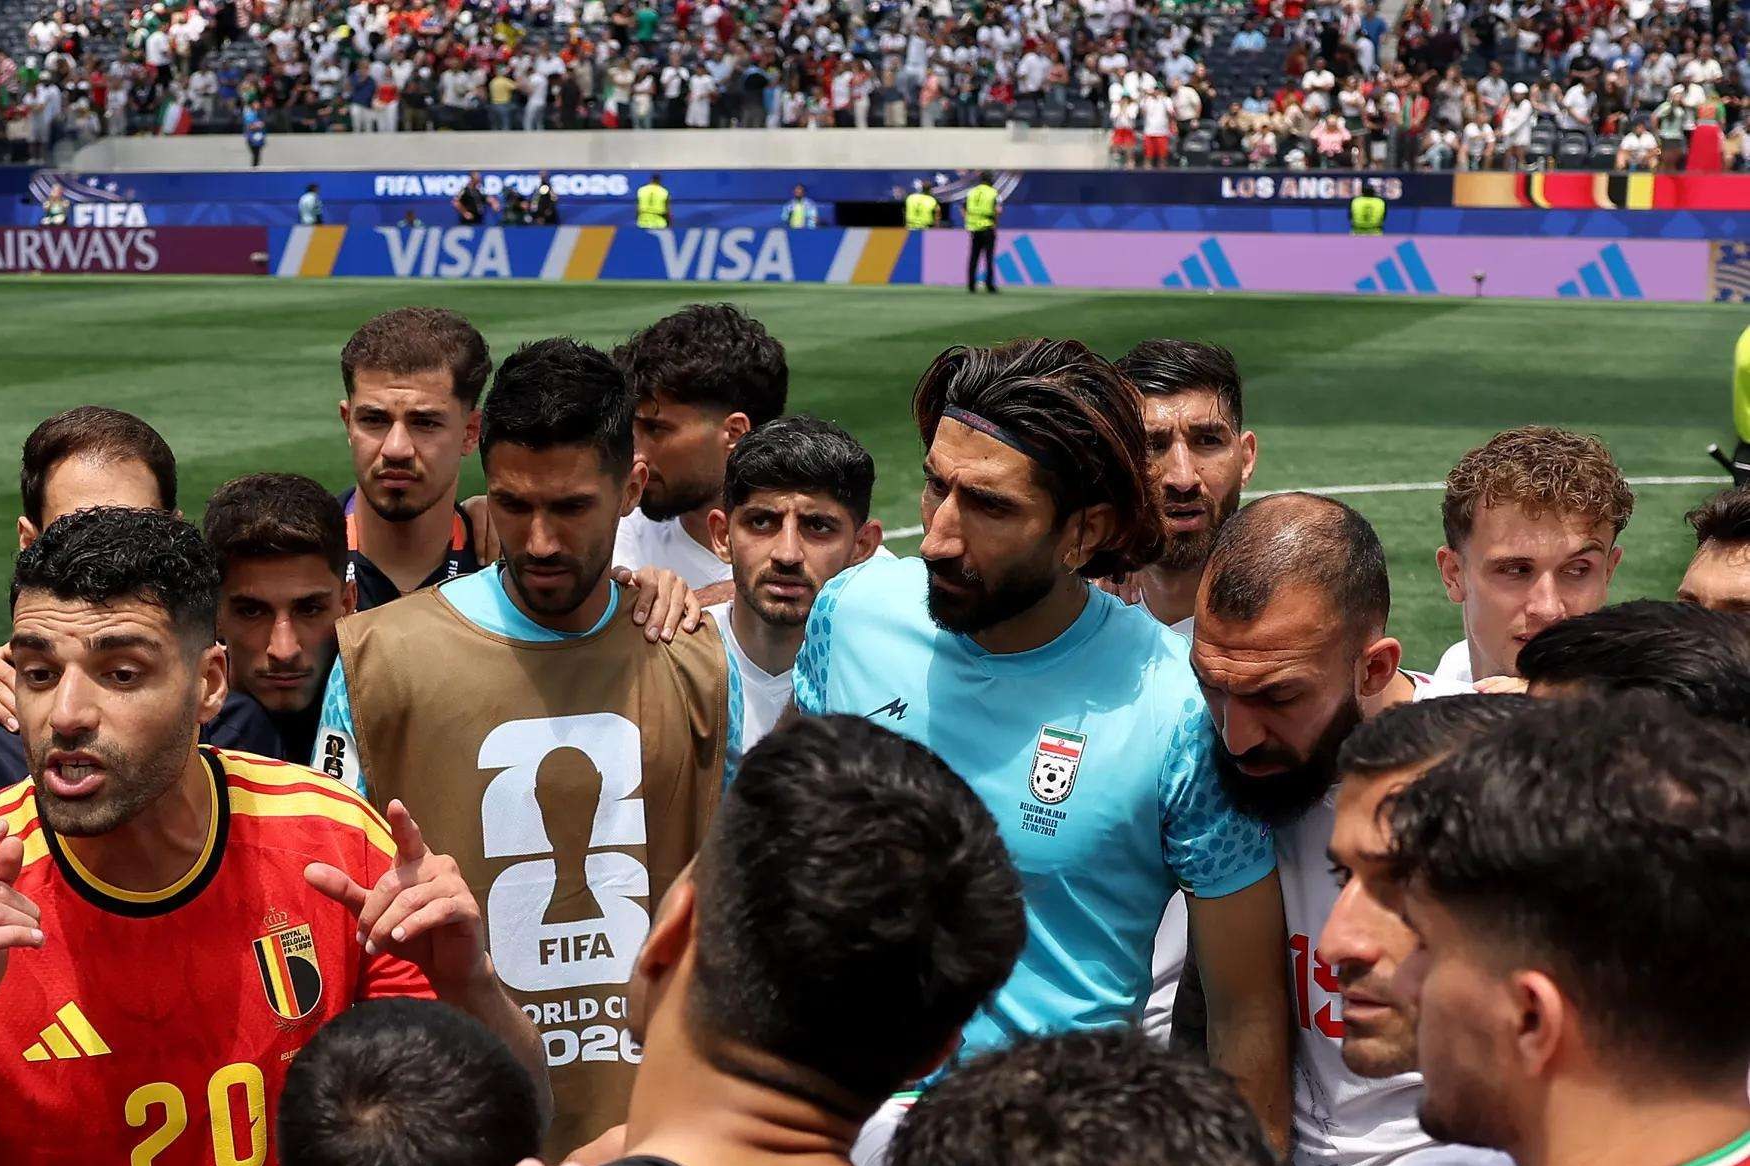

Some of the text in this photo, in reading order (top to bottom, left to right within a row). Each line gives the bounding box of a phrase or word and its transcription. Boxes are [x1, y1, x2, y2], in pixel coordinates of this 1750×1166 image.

[374, 175, 423, 196] FIFA
[550, 174, 629, 196] 2026
[1221, 176, 1276, 199] LOS
[73, 202, 148, 228] FIFA
[373, 226, 512, 278] VISA
[645, 227, 796, 281] VISA
[280, 929, 301, 941] ROYAL
[282, 934, 311, 948] BELGIAN
[539, 932, 615, 966] FIFA
[521, 997, 599, 1025] ORLD
[541, 1024, 644, 1067] 026
